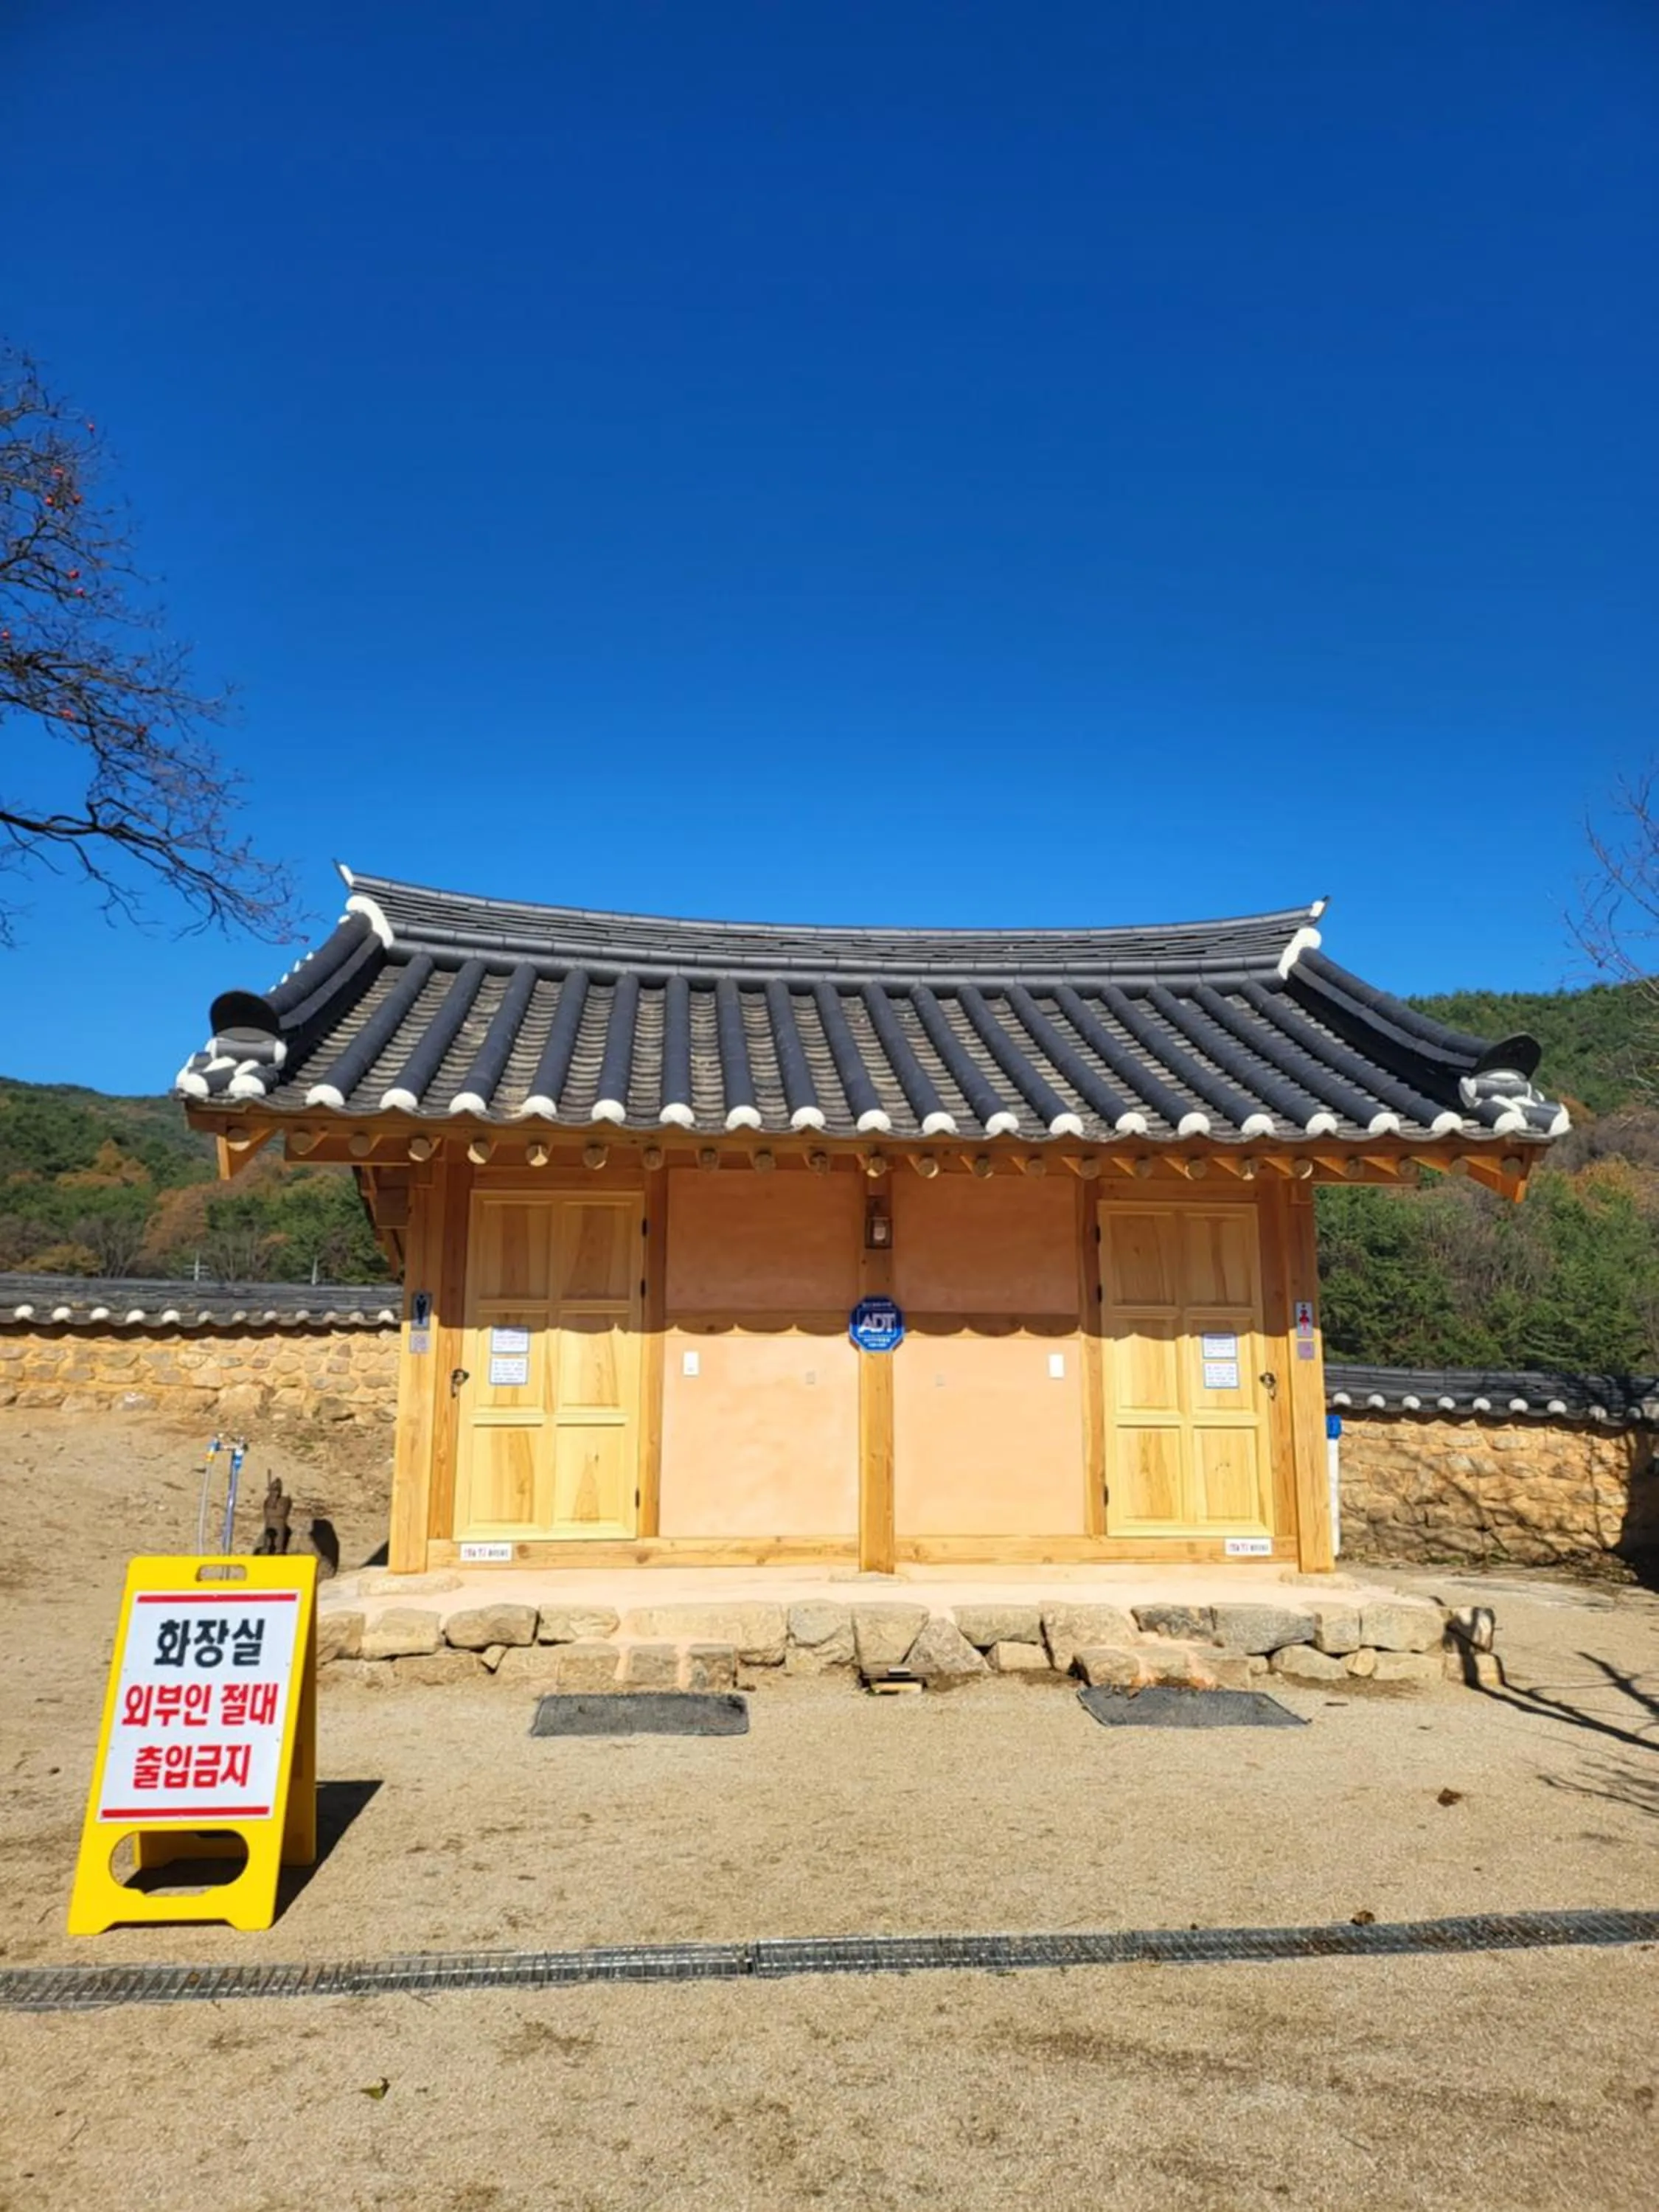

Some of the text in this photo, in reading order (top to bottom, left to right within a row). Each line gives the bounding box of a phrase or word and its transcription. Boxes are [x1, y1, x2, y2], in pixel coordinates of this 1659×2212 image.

[859, 1312, 896, 1333] ADT
[153, 1618, 265, 1668] 화장실
[121, 1683, 279, 1727] 외부인 절대
[132, 1745, 252, 1789] 출입금지
